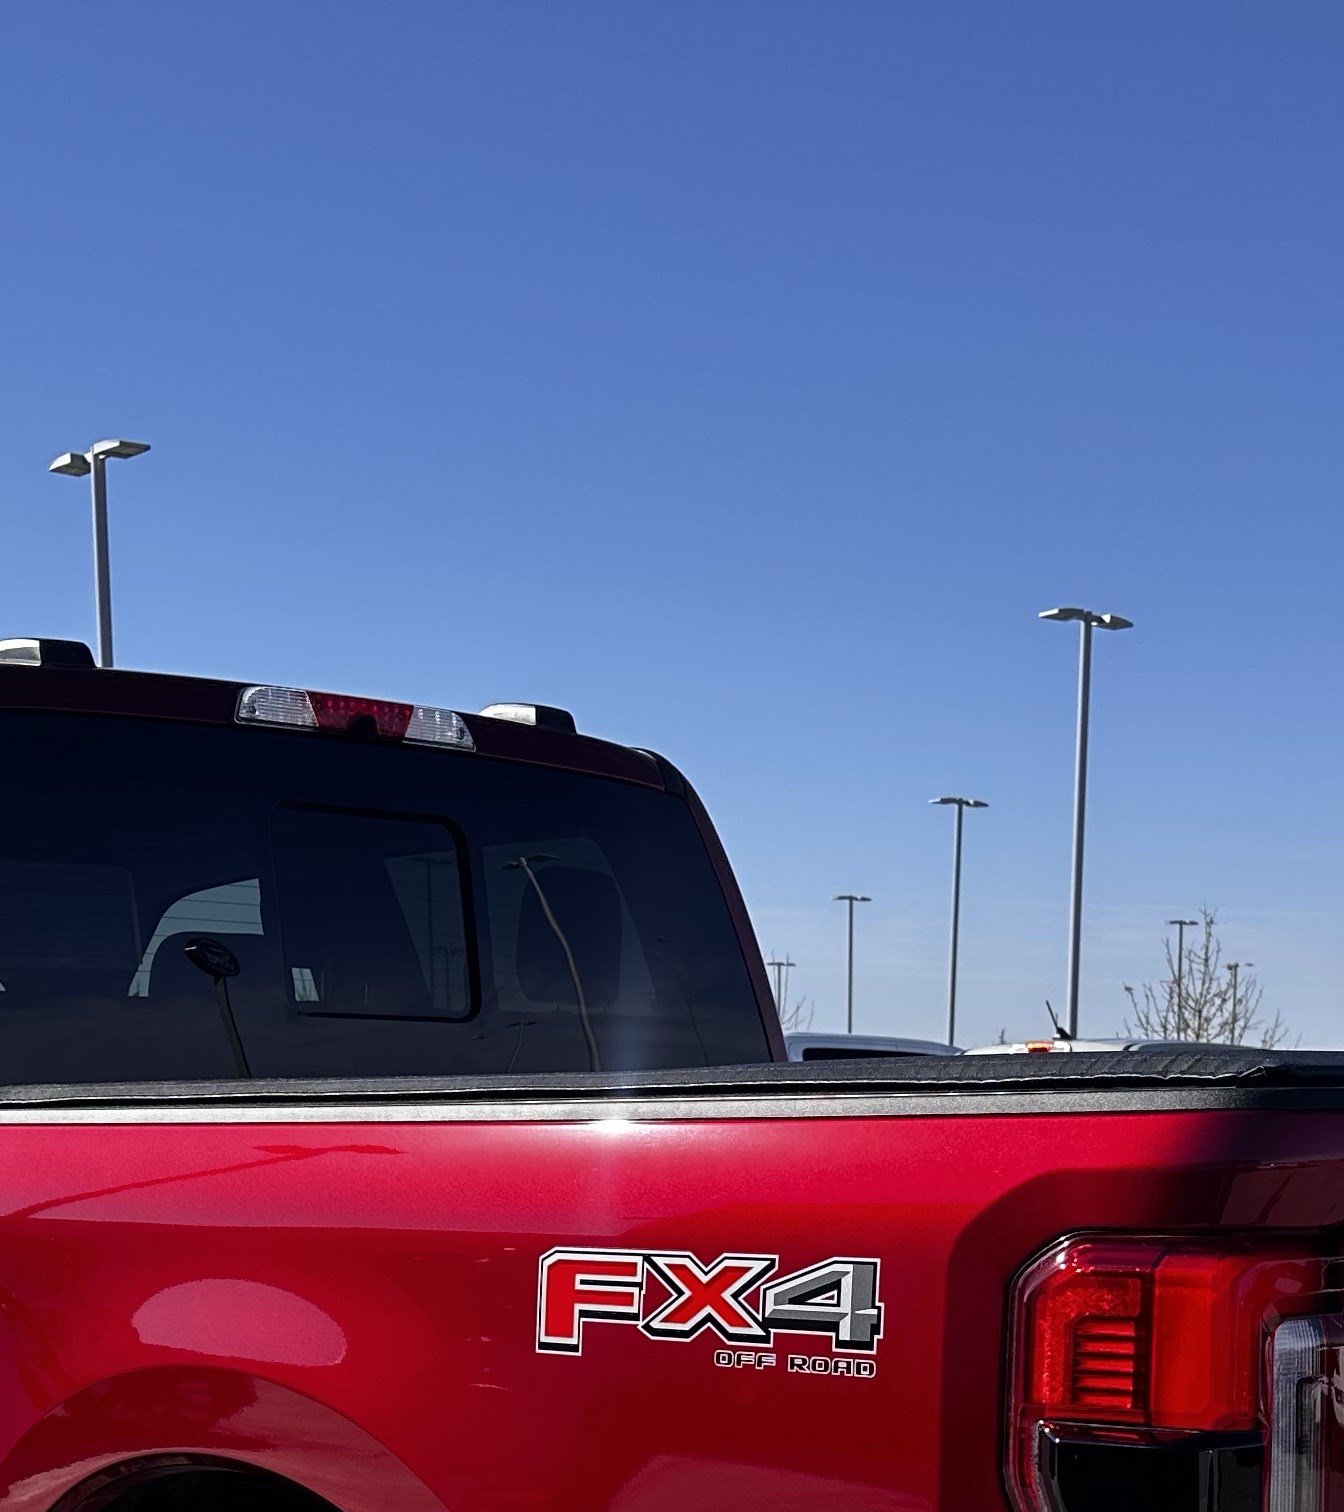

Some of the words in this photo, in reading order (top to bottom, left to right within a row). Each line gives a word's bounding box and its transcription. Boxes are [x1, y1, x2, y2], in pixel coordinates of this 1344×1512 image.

[536, 1246, 885, 1357] FX4
[714, 1350, 777, 1370] OFF
[788, 1355, 877, 1379] ROAD
